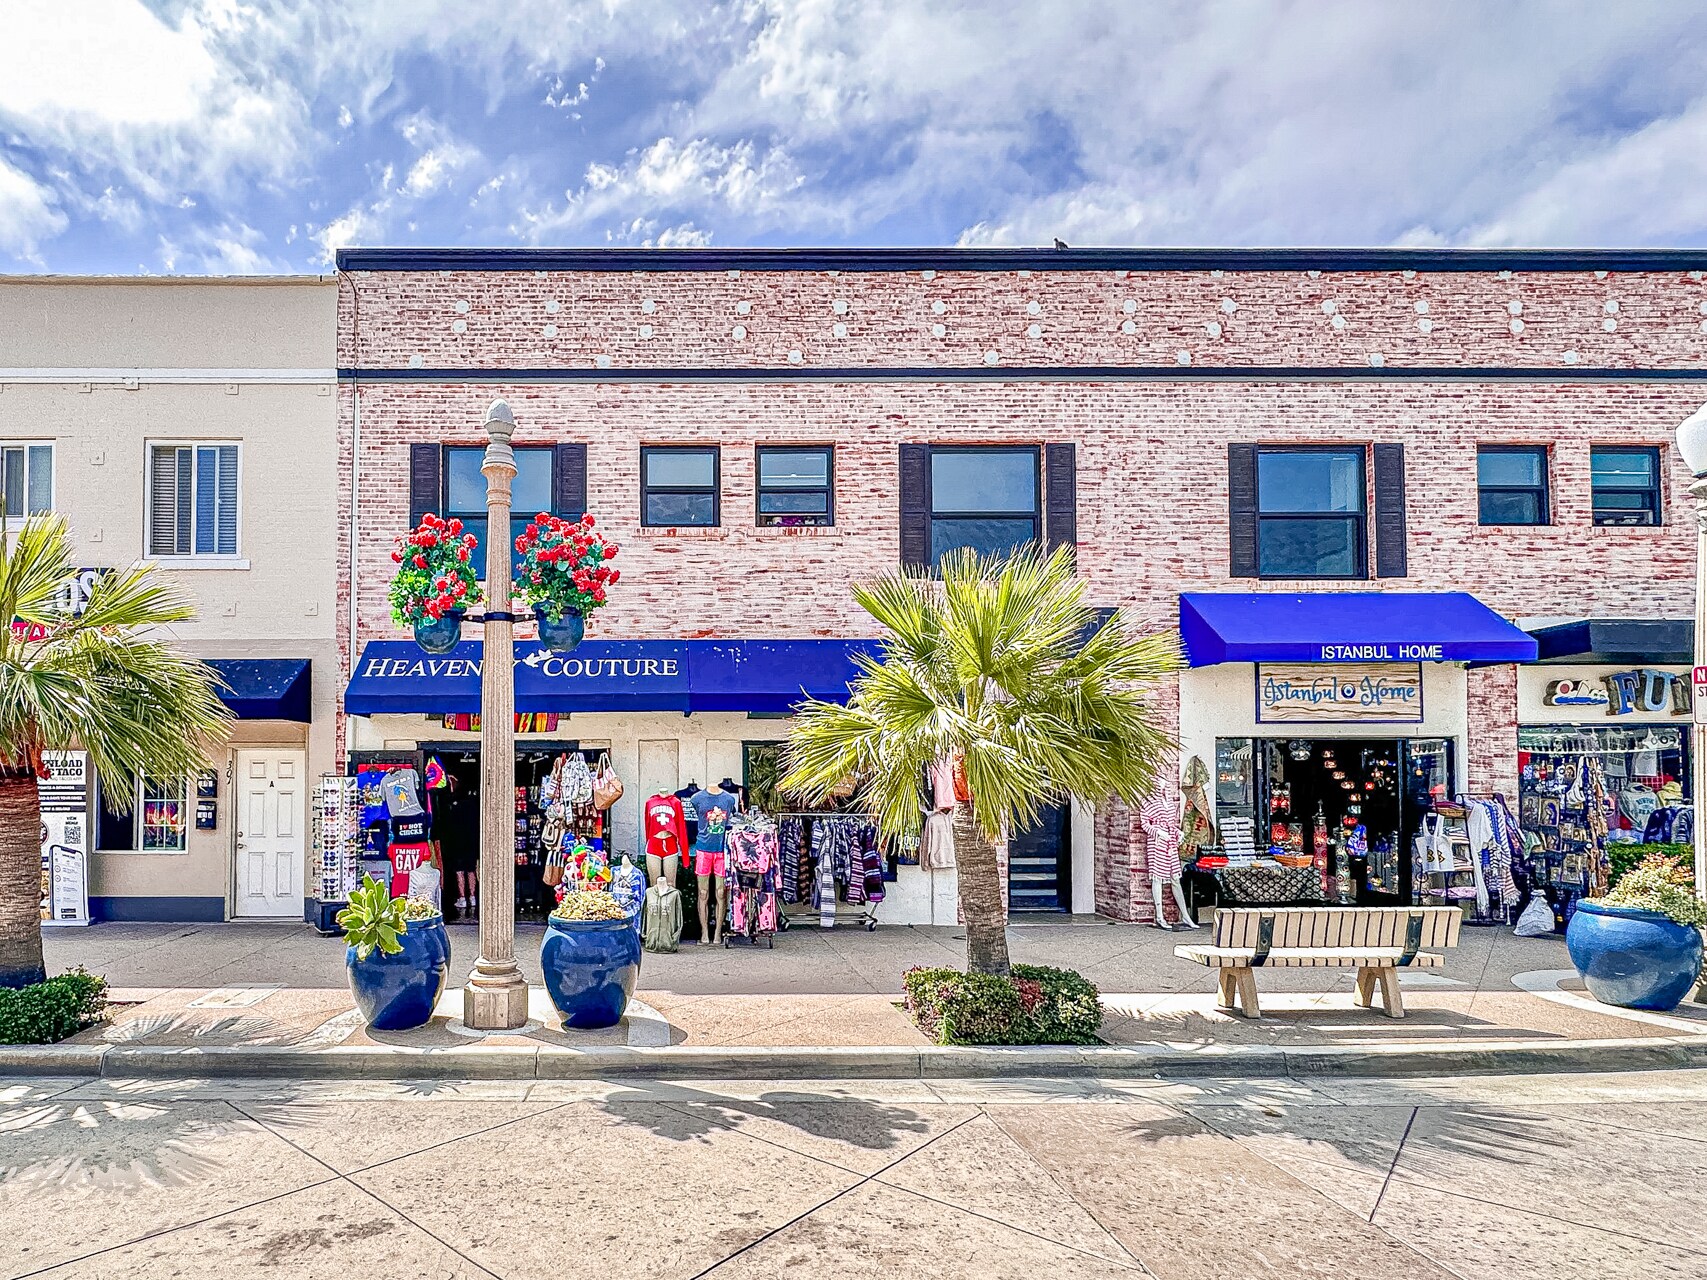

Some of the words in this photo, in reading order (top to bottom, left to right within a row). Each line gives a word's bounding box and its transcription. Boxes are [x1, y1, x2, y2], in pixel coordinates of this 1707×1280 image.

[1321, 645, 1393, 660] ISTANBUL
[1399, 645, 1443, 659] HOME
[361, 657, 521, 678] HEAVEN
[542, 656, 679, 678] COUTURE
[1264, 676, 1337, 706] Istanbul
[1359, 676, 1416, 706] Home
[56, 768, 82, 776] TACO
[269, 780, 275, 788] A
[395, 854, 420, 871] GAY
